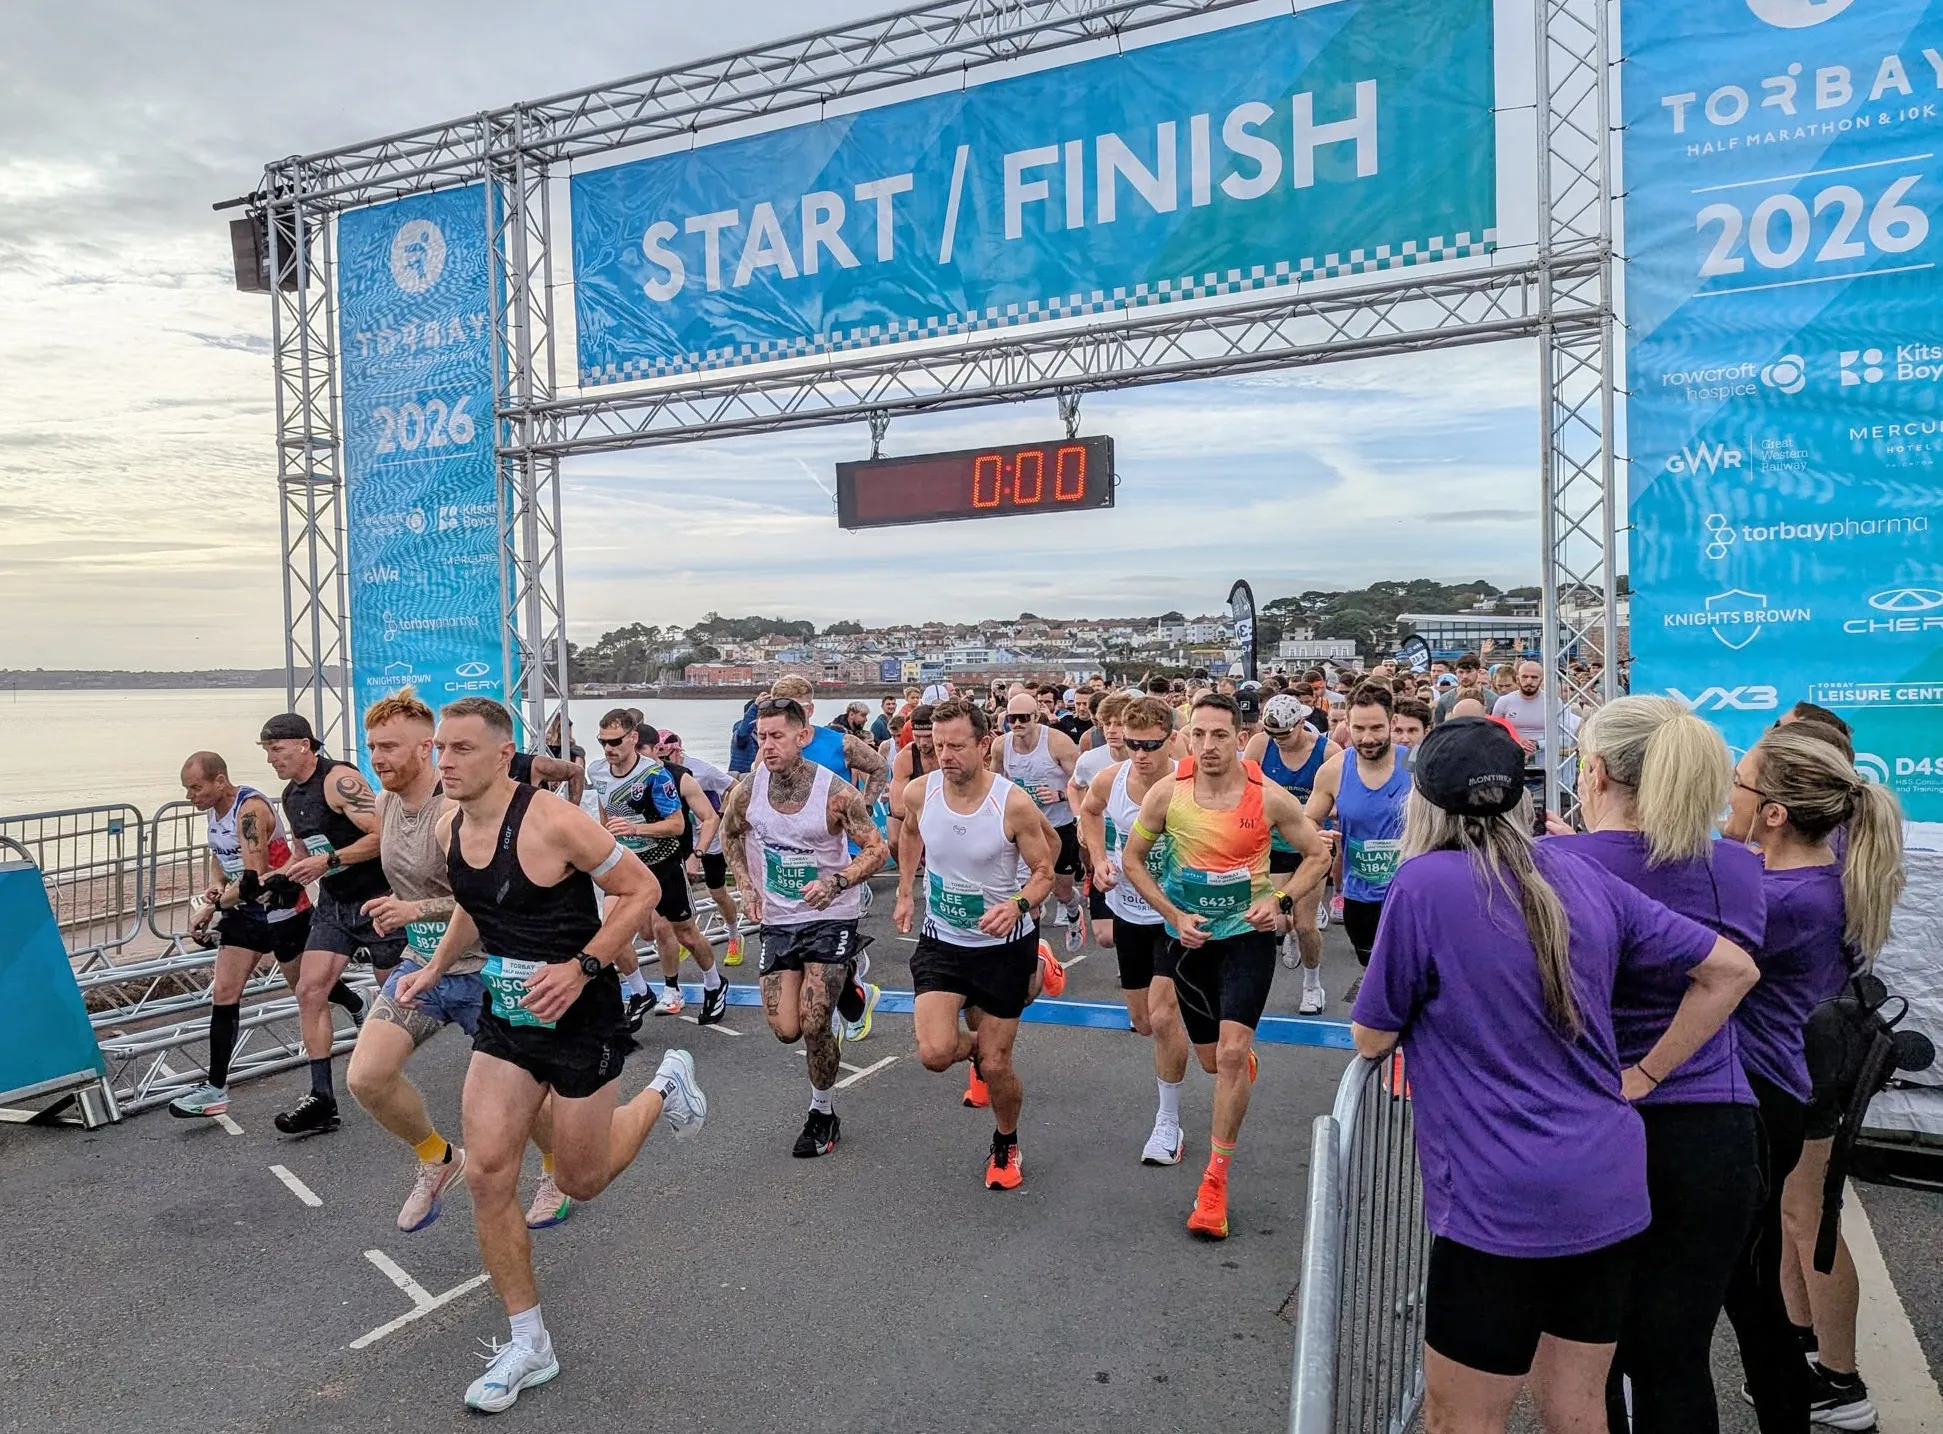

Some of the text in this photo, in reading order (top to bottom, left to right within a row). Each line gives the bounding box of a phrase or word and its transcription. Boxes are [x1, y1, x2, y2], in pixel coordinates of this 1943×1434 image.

[1661, 48, 1943, 133] TORBAY
[1687, 137, 1739, 157] HALF
[1747, 116, 1870, 147] MARATHON
[1878, 112, 1892, 125] &
[640, 173, 913, 303] START
[1003, 78, 1378, 241] FINISH
[1696, 174, 1929, 277] 2026
[1662, 362, 1757, 388] rowcroft
[1686, 381, 1757, 403] hospice
[373, 395, 475, 454] 2026
[1849, 420, 1943, 441] MERCU
[1761, 438, 1793, 450] Great
[1886, 444, 1932, 454] HOTEL
[1665, 440, 1742, 477] GWR
[1761, 448, 1809, 461] Western
[1761, 459, 1807, 473] Railway
[971, 446, 1087, 510] 0:00
[462, 515, 497, 529] Boyce
[1742, 516, 1929, 542] torbaypharma
[364, 564, 400, 586] GWR
[1664, 608, 1811, 628] KNIGHTS BROWN
[366, 673, 432, 687] KNIGHTS BROWN
[444, 679, 501, 692] CHERY
[1665, 685, 1779, 711] VX3
[1818, 688, 1892, 701] LEISURE
[1896, 785, 1911, 793] and
[503, 825, 513, 850] soar
[1355, 850, 1393, 862] ALLAN
[775, 865, 805, 878] OLLIE
[1360, 862, 1388, 873] 5184
[941, 891, 962, 905] LEE
[1199, 896, 1236, 908] 6423
[939, 902, 967, 917] 6146
[510, 962, 536, 971] TORBAY
[598, 1043, 611, 1076] soar
